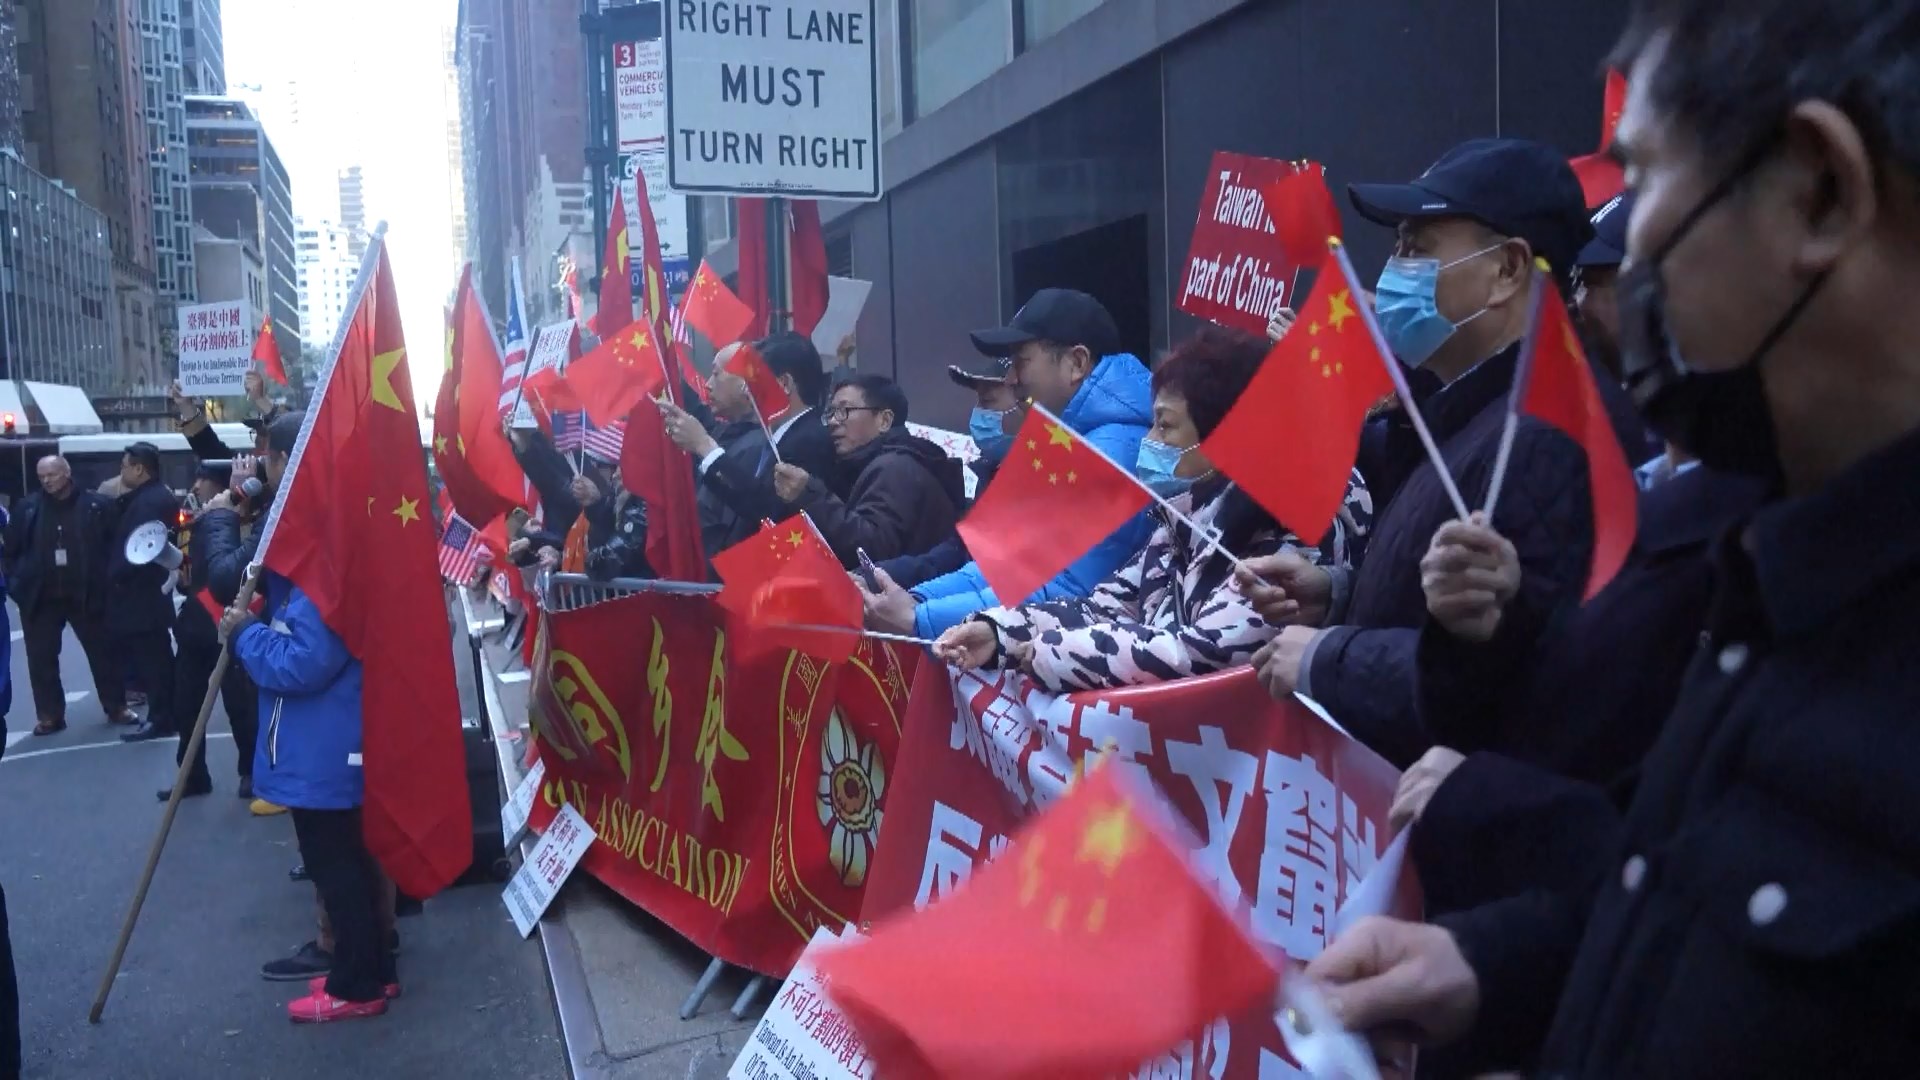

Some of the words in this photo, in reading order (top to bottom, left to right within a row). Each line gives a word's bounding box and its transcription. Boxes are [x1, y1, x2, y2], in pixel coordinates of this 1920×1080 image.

[679, 0, 771, 38] RIGHT
[787, 8, 864, 44] LANE
[620, 45, 632, 66] 3
[619, 83, 657, 97] VEHICLES
[721, 63, 825, 108] MUST
[680, 128, 763, 165] TURN
[778, 135, 867, 170] RIGHT
[1213, 170, 1266, 231] Taiwan
[1182, 252, 1221, 306] part
[1217, 253, 1242, 306] of
[1235, 255, 1285, 320] China
[238, 357, 249, 368] Part
[593, 793, 750, 918] ASSOCIATION
[756, 1019, 781, 1054] Taiwan
[775, 1039, 788, 1060] Is
[782, 1047, 797, 1071] An
